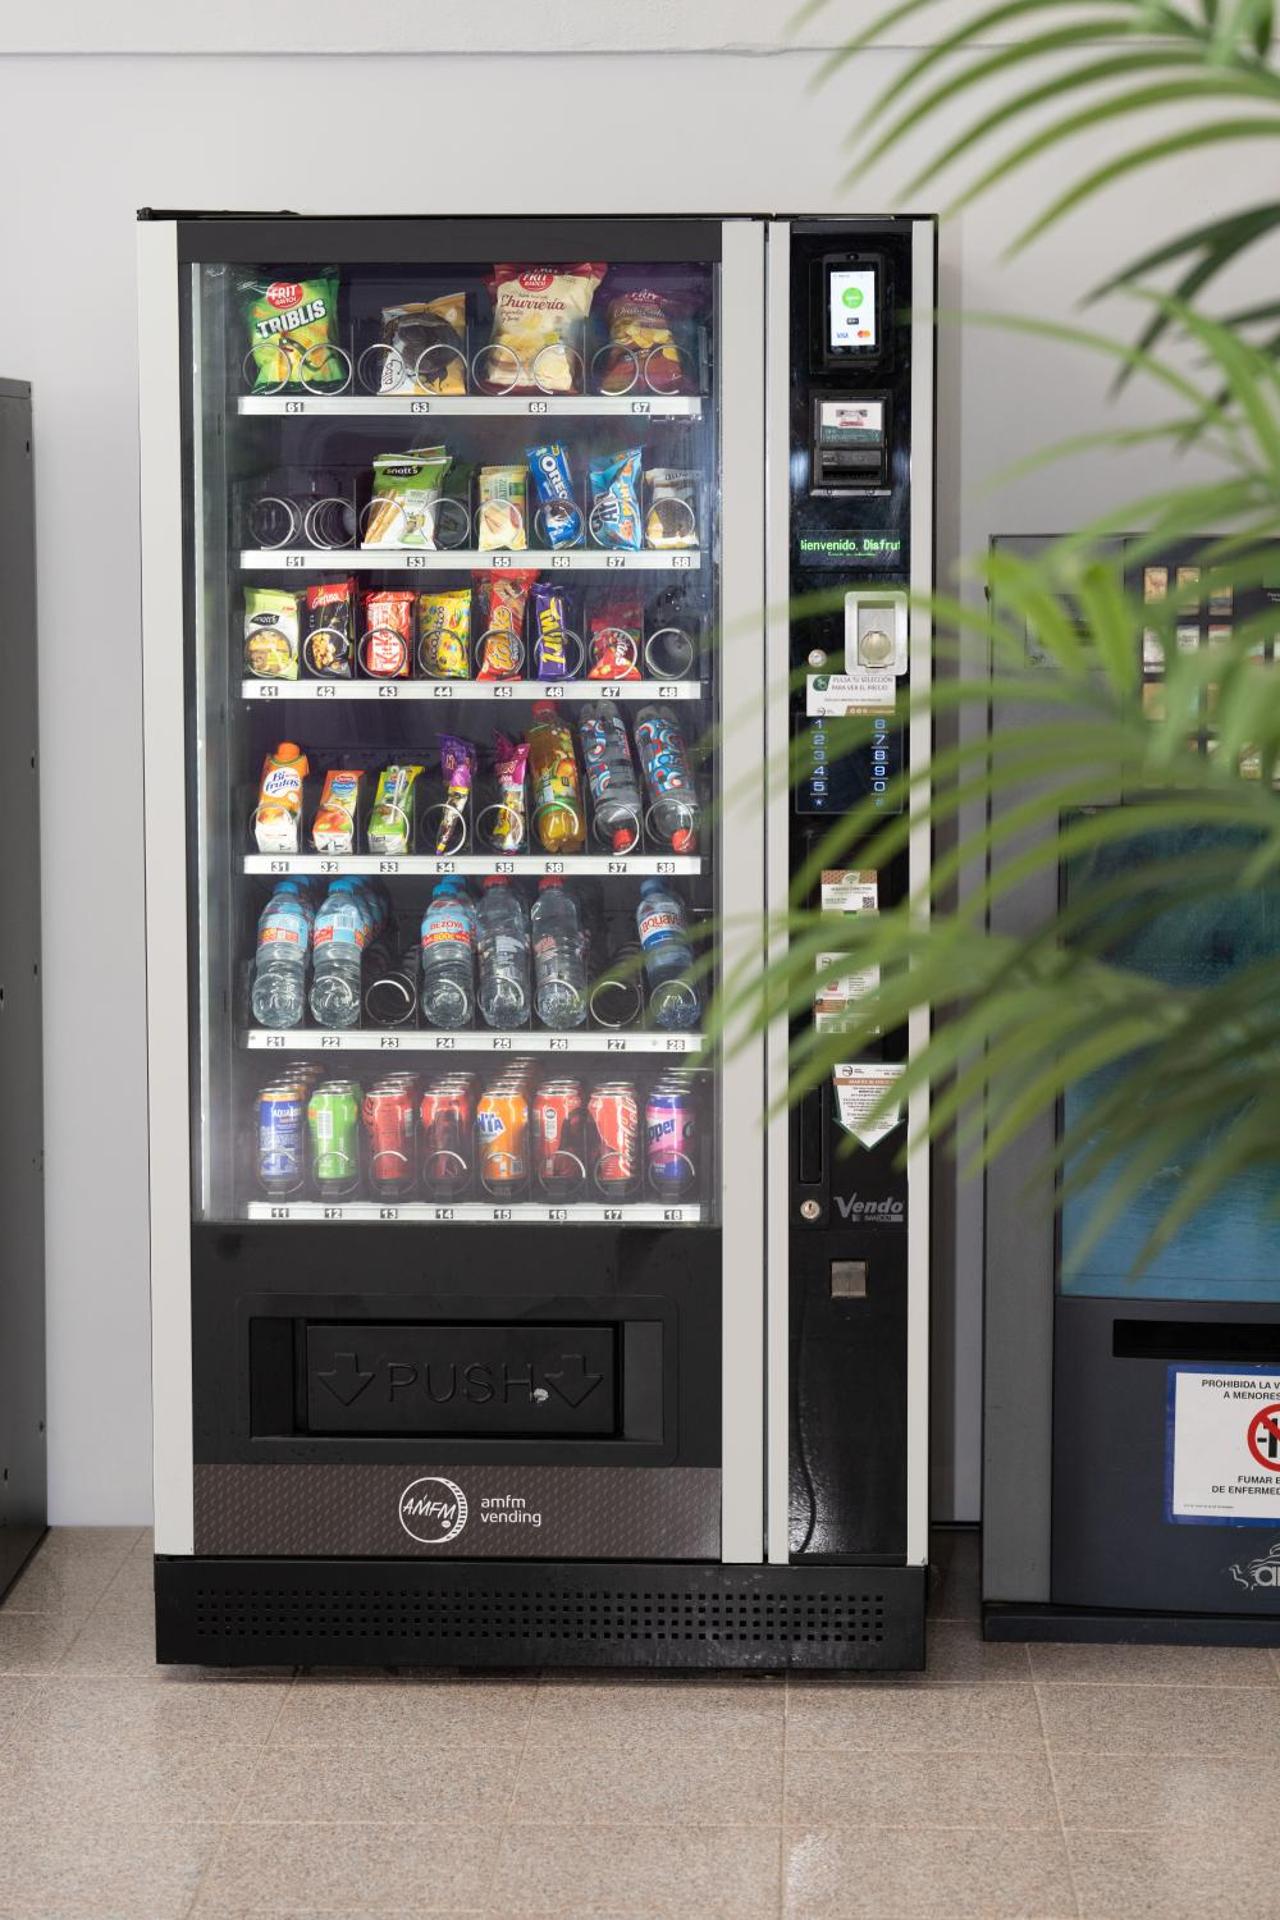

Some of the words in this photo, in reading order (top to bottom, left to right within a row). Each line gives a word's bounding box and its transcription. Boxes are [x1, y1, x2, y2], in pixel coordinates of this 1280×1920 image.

[268, 285, 298, 300] FRIT
[256, 299, 326, 339] TRIBLIS
[286, 402, 304, 412] 61
[411, 402, 430, 412] 63
[529, 402, 547, 412] 65
[632, 402, 649, 412] 67
[541, 455, 568, 499] OREO
[286, 557, 304, 567] 51
[407, 557, 425, 567] 53
[493, 557, 511, 567] 55
[552, 557, 570, 567] 56
[607, 557, 625, 567] 57
[672, 557, 690, 567] 58
[261, 687, 278, 696] 41
[317, 687, 334, 696] 42
[379, 687, 397, 696] 43
[434, 687, 452, 696] 44
[494, 687, 512, 697] 45
[546, 687, 563, 697] 46
[602, 687, 620, 697] 47
[659, 687, 677, 697] 48
[815, 719, 822, 729] 1
[813, 735, 825, 745] 2
[874, 735, 885, 745] 7
[813, 750, 825, 760] 3
[874, 750, 885, 760] 8
[814, 766, 825, 775] 4
[874, 766, 885, 776] 9
[265, 779, 299, 793] frutas
[873, 781, 886, 791] 0
[272, 862, 289, 872] 31
[321, 862, 338, 872] 32
[380, 862, 398, 872] 33
[437, 862, 454, 872] 34
[496, 863, 513, 873] 35
[546, 863, 563, 872] 36
[609, 863, 626, 872] 37
[657, 863, 675, 872] 38
[268, 1038, 284, 1048] 21
[322, 1038, 339, 1048] 22
[381, 1038, 398, 1048] 23
[437, 1038, 454, 1048] 24
[494, 1038, 511, 1048] 25
[550, 1039, 568, 1048] 26
[608, 1040, 625, 1049] 27
[667, 1039, 685, 1049] 28
[833, 1192, 903, 1218] Vendo
[272, 1209, 289, 1218] 11
[325, 1209, 342, 1218] 12
[380, 1209, 398, 1219] 13
[436, 1209, 453, 1219] 14
[494, 1209, 511, 1219] 15
[549, 1209, 567, 1219] 16
[604, 1210, 622, 1219] 17
[664, 1210, 682, 1220] 18
[387, 1363, 537, 1403] PUSH
[1202, 1379, 1256, 1389] PROHIBIDA
[1223, 1391, 1230, 1399] A
[1233, 1391, 1280, 1400] MENORES
[1237, 1475, 1273, 1484] FUMAR
[1211, 1485, 1226, 1493] DE
[481, 1495, 526, 1508] amfm
[403, 1497, 457, 1520] AMFM
[481, 1510, 542, 1527] vending
